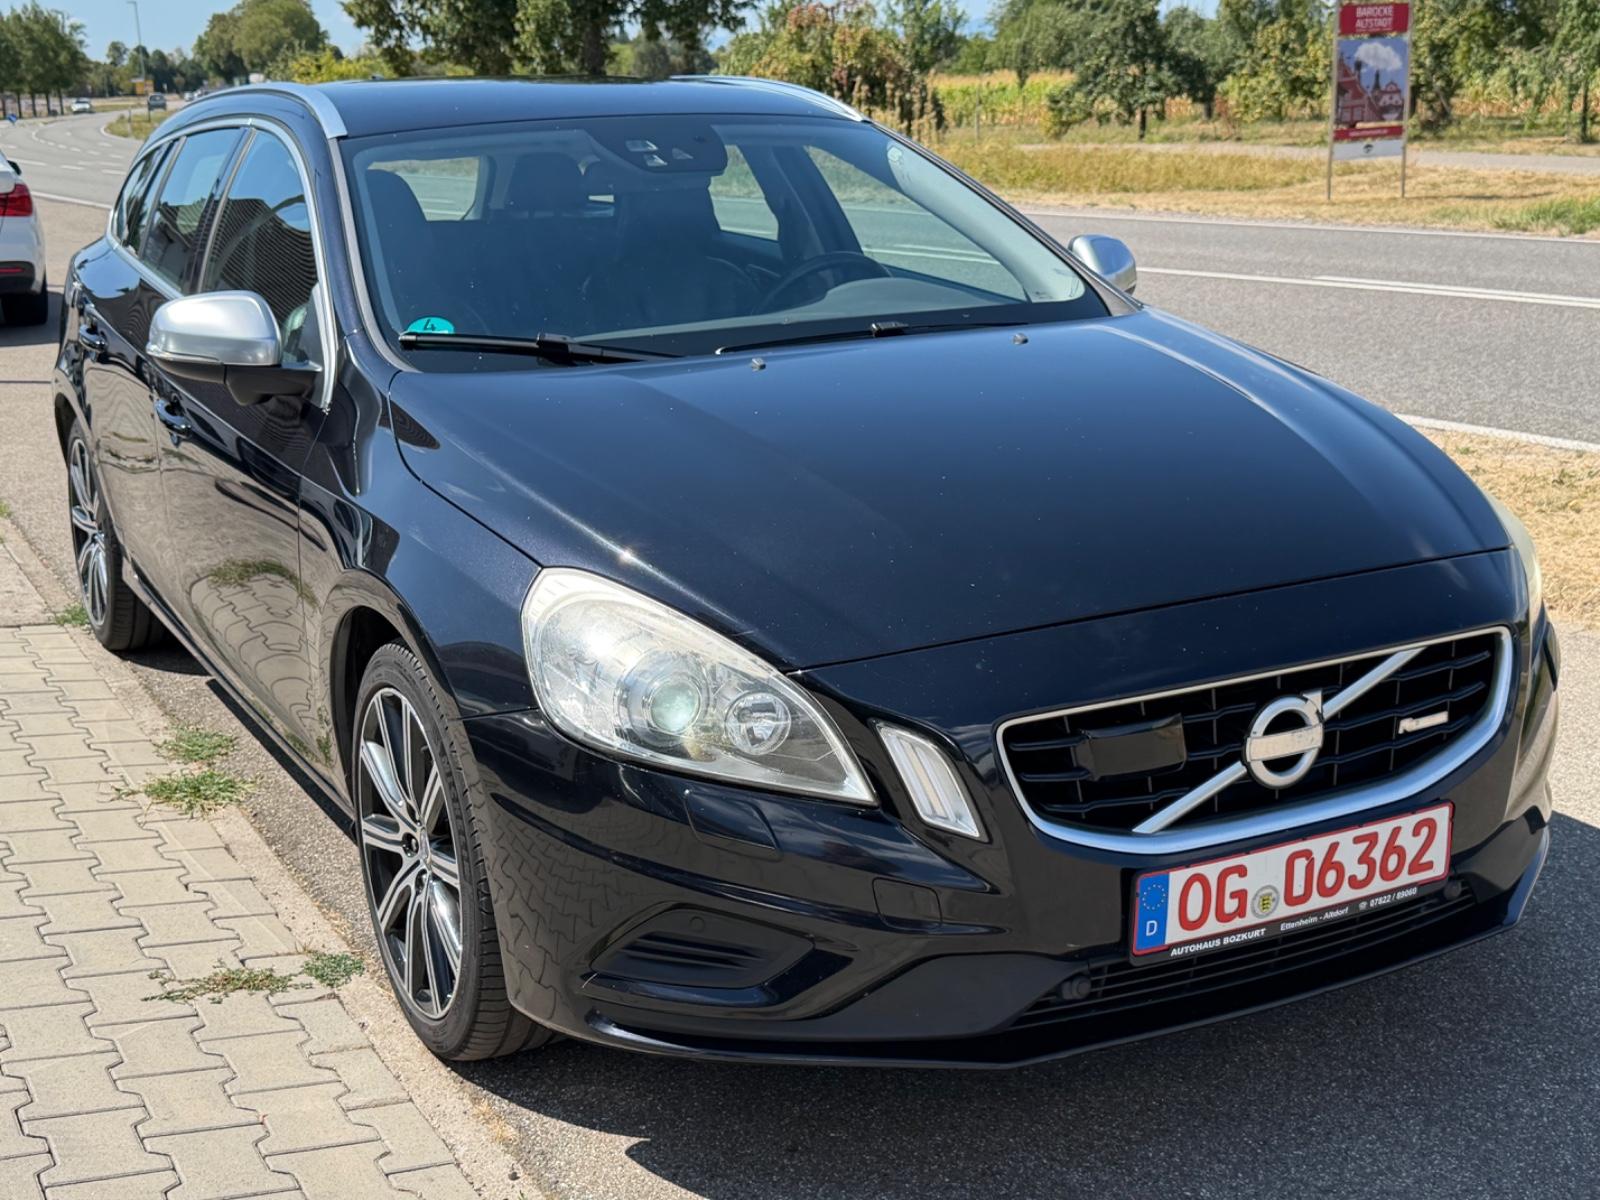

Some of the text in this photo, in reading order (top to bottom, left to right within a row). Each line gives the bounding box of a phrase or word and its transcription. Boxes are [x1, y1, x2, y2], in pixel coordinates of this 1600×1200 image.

[424, 319, 437, 331] 4
[1178, 817, 1437, 931] OG 06362
[1146, 920, 1158, 936] D
[1170, 938, 1221, 957] AUTOHAUS
[1223, 927, 1267, 946] BOZKURT
[1281, 916, 1318, 931] Ettenheim
[1323, 906, 1349, 920] Altdorf
